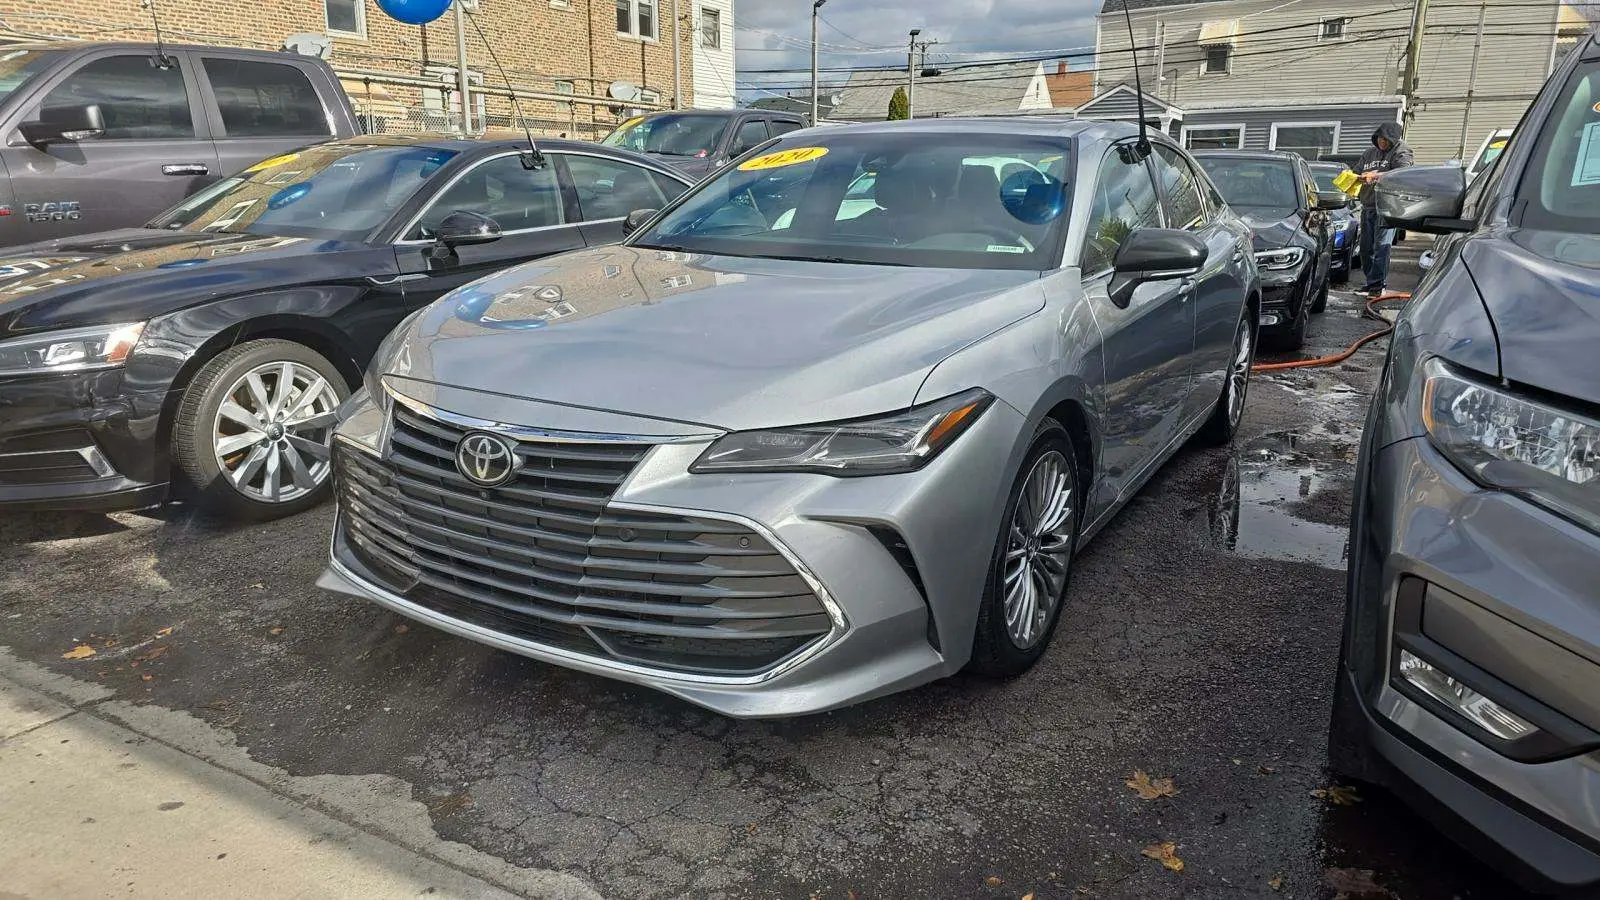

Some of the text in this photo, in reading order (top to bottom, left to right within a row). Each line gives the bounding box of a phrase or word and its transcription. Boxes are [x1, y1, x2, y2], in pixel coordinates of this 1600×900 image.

[748, 149, 815, 168] 2020
[24, 201, 80, 212] RAM
[25, 211, 81, 222] 1500
